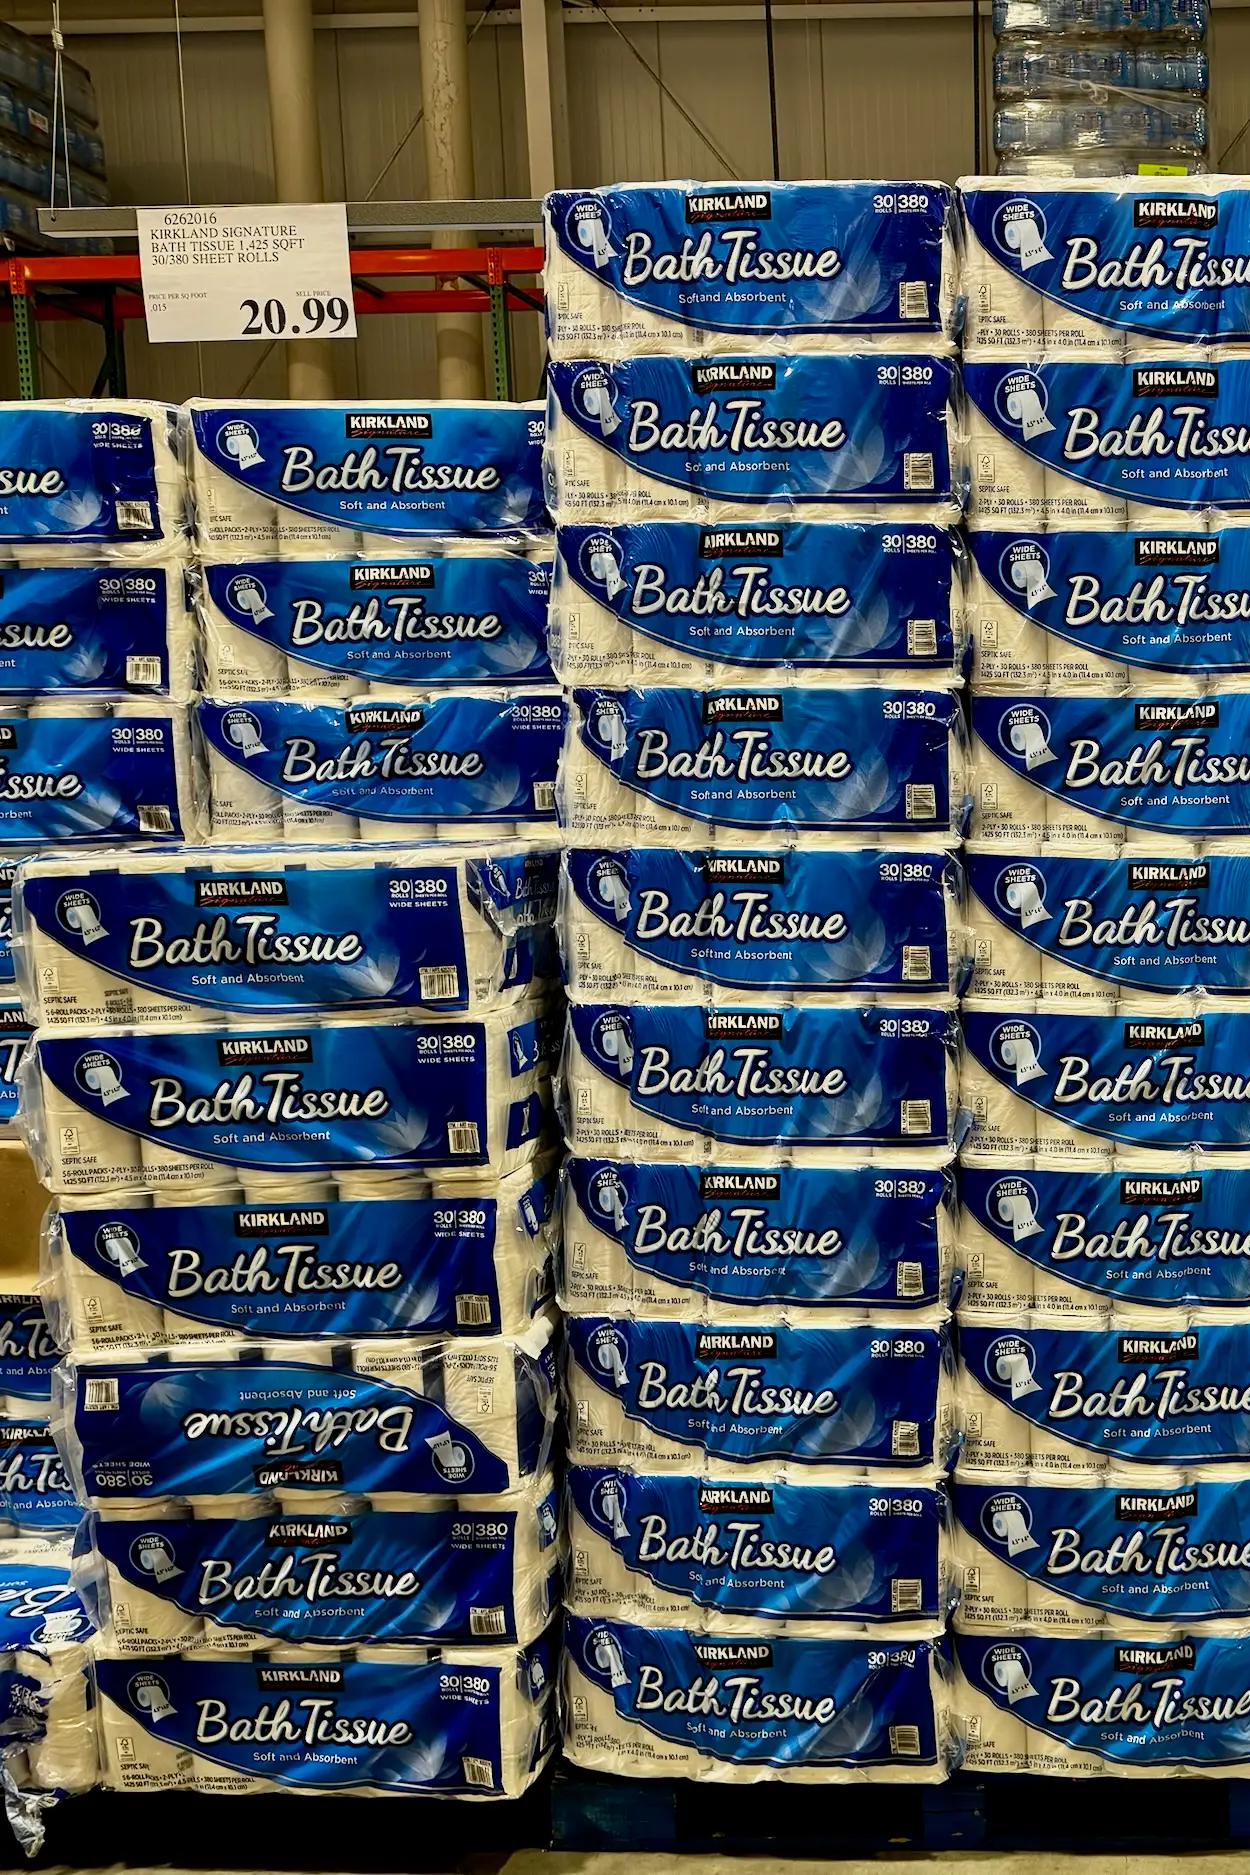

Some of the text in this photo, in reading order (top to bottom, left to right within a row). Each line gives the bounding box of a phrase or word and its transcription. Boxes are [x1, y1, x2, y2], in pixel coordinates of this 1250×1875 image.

[1005, 203, 1030, 214] WIDE
[1139, 202, 1216, 218] KIRKLAND
[164, 212, 217, 225] 6262016
[1002, 211, 1035, 222] SHEETS
[151, 225, 297, 240] KIRKLAND SIGNATURE
[151, 238, 305, 253] BATH TISSUE 1,425 SQFT
[152, 251, 279, 266] 30/380 SHEET ROLLS
[1062, 237, 1174, 290] Bath
[150, 303, 167, 312] .015
[1119, 299, 1225, 311] Soft and Absorbent
[239, 297, 349, 335] 20.99
[706, 860, 781, 875] KIRKLAND
[879, 863, 932, 878] 30 380
[200, 881, 283, 897] KIRKLAND
[389, 879, 448, 894] 30 380
[63, 897, 91, 908] SHEETS
[64, 892, 85, 901] WIDE
[415, 900, 448, 908] SHEETS
[636, 889, 847, 940] Bath Tissue
[129, 915, 363, 968] Bath Tissue
[191, 973, 304, 985] Soft and Absorbent
[43, 996, 63, 1004] SEPTIC
[239, 1388, 357, 1400] Soft Absorbent
[185, 1404, 414, 1456] Bath Tissue
[95, 1472, 153, 1487] 30 380
[259, 1468, 338, 1485] KIRKLAND
[1119, 1646, 1193, 1665] KIRKLAND
[1047, 1676, 1153, 1725] Bath
